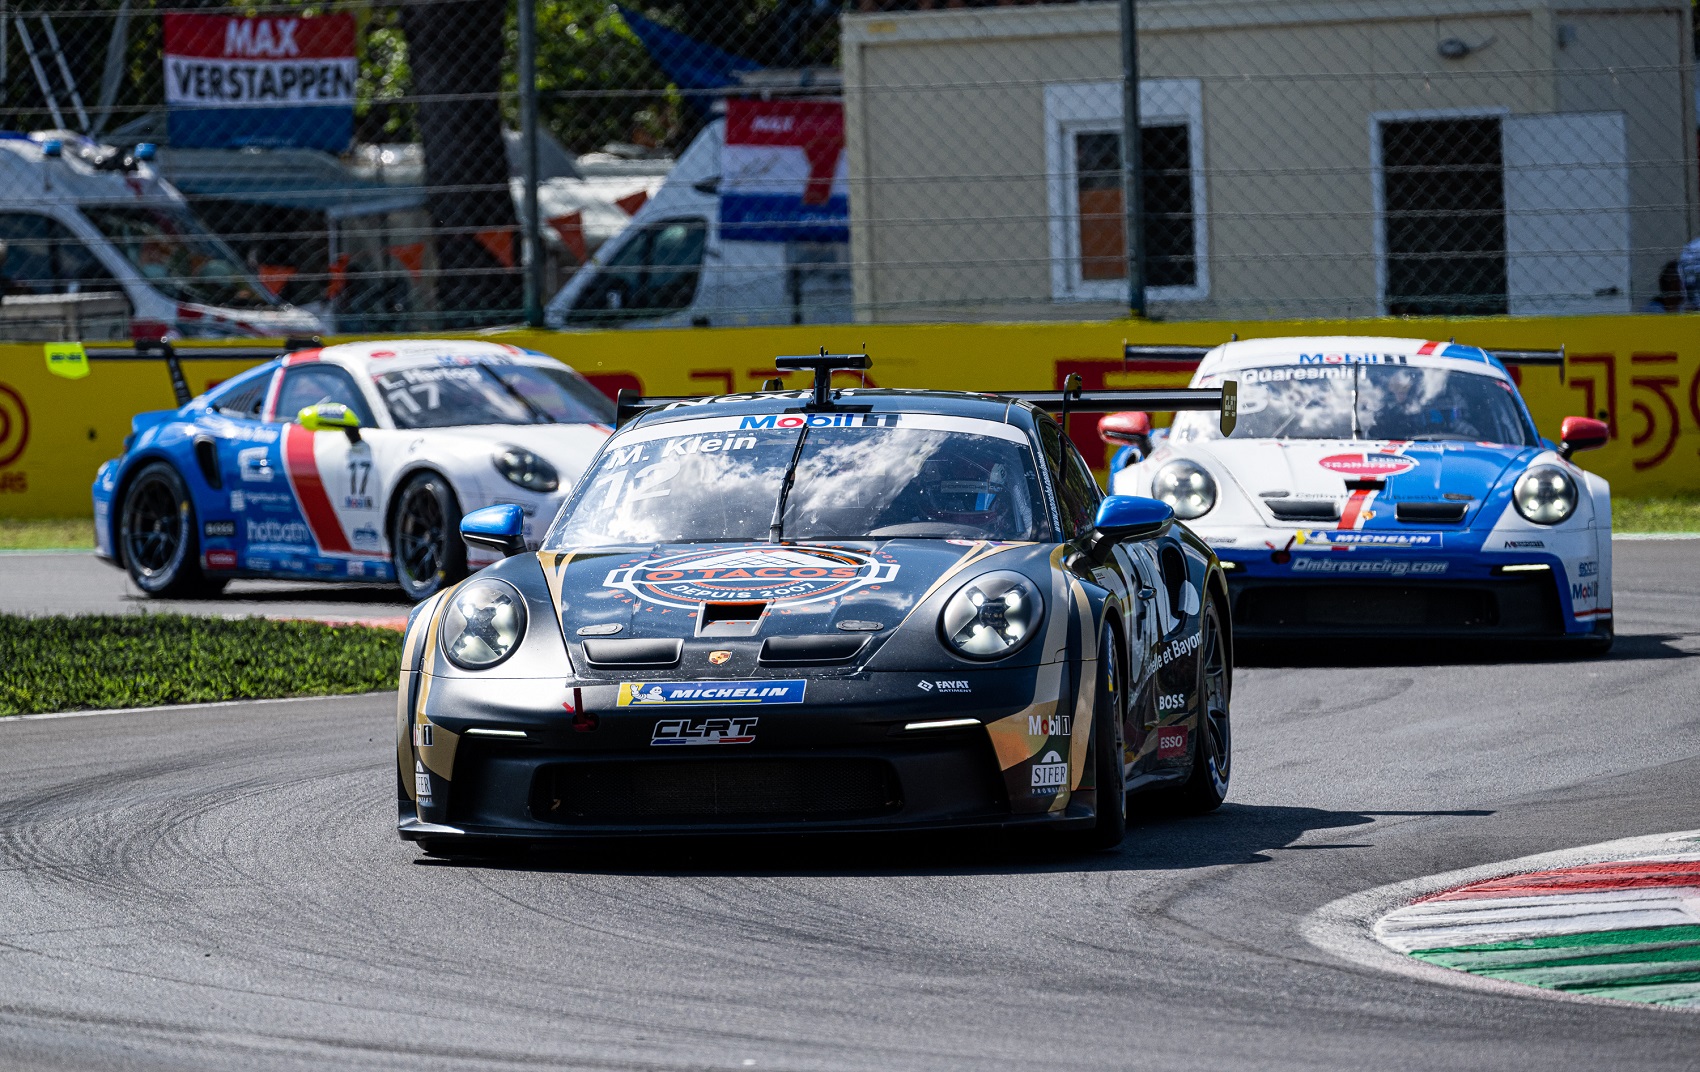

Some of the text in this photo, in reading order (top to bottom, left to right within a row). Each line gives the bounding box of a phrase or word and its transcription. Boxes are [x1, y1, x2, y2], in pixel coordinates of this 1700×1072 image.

[224, 18, 299, 56] MAX
[173, 62, 354, 99] VERSTAPPEN
[1300, 353, 1378, 365] Mobil
[1242, 365, 1367, 385] Quaresmini
[388, 382, 441, 413] 17
[739, 413, 853, 430] Mobil
[605, 432, 758, 470] M. Klein
[347, 461, 372, 496] 17
[594, 461, 681, 511] 12
[1335, 533, 1432, 544] MICHELIN
[645, 567, 857, 581] O'TACOS
[671, 582, 815, 600] DEPUIS 2007
[1162, 646, 1174, 665] et
[669, 687, 789, 698] MICHELIN
[935, 680, 970, 689] FAYAT
[1159, 693, 1185, 711] BOSS
[1028, 715, 1061, 736] Mobil
[1160, 735, 1183, 749] ESSO
[1034, 766, 1066, 784] SIFER
